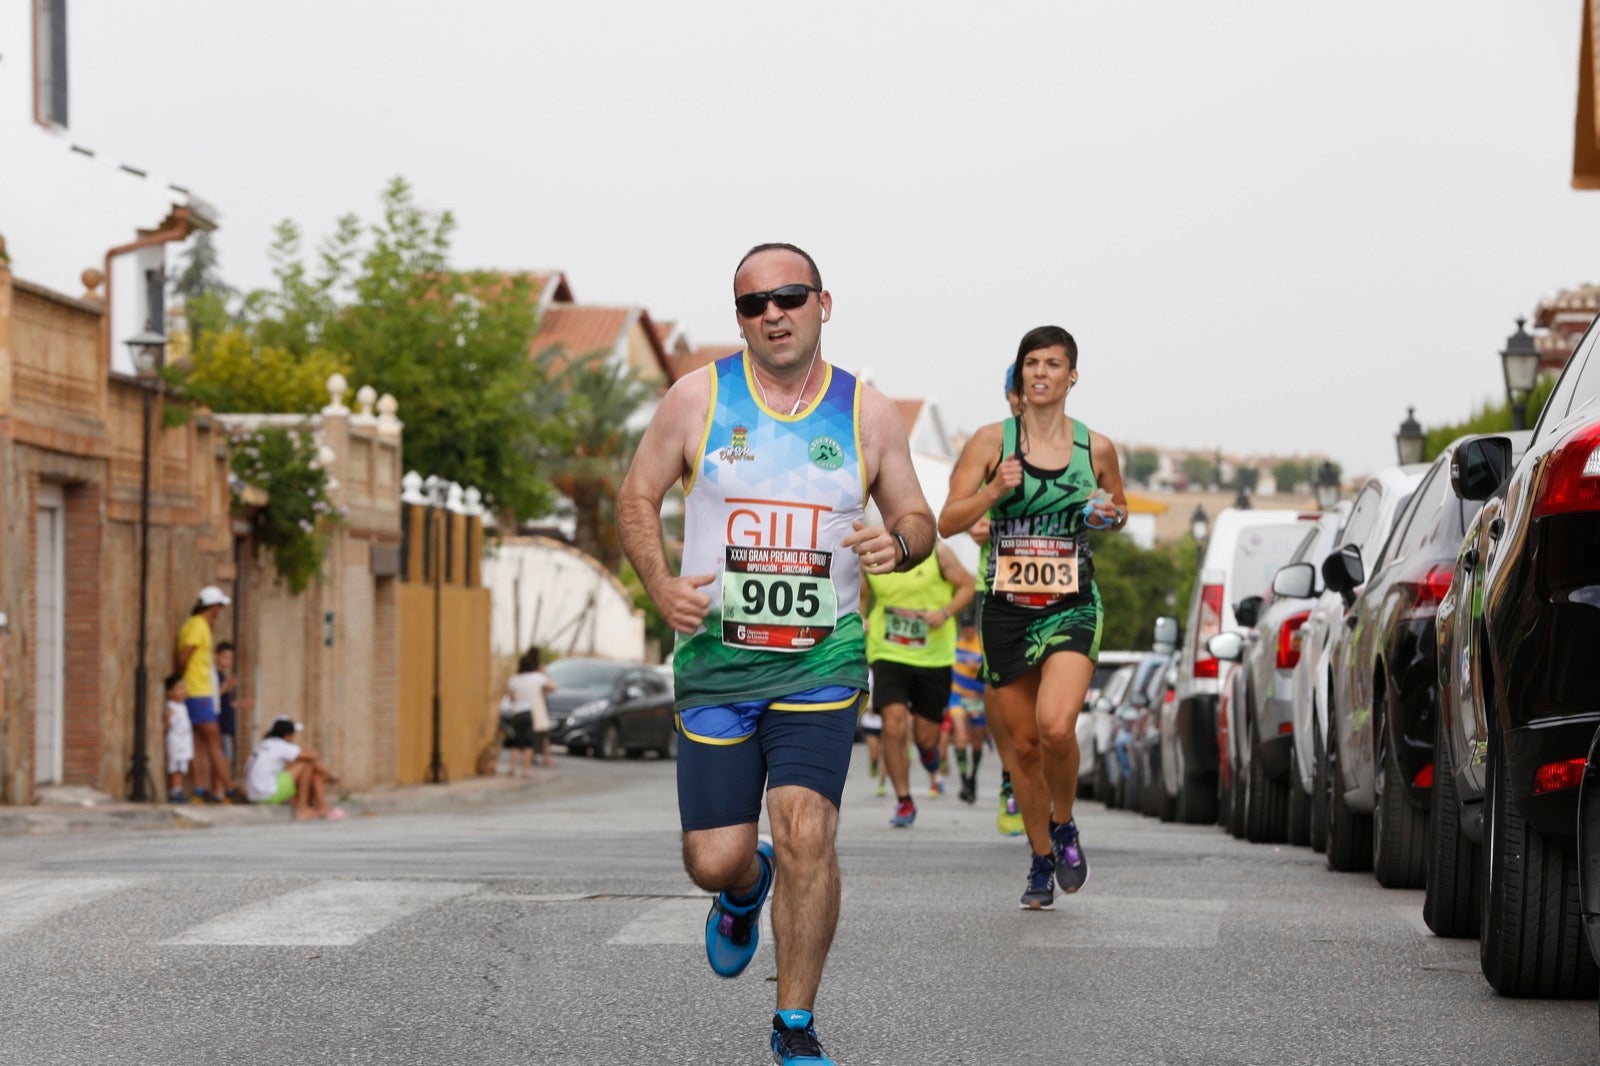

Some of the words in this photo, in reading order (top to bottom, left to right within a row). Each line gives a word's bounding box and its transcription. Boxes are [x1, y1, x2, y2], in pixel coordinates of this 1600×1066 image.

[748, 549, 768, 562] GRAN
[770, 550, 797, 564] PREMIO
[799, 552, 808, 565] DE
[1008, 561, 1072, 586] 2003
[741, 579, 820, 618] 905
